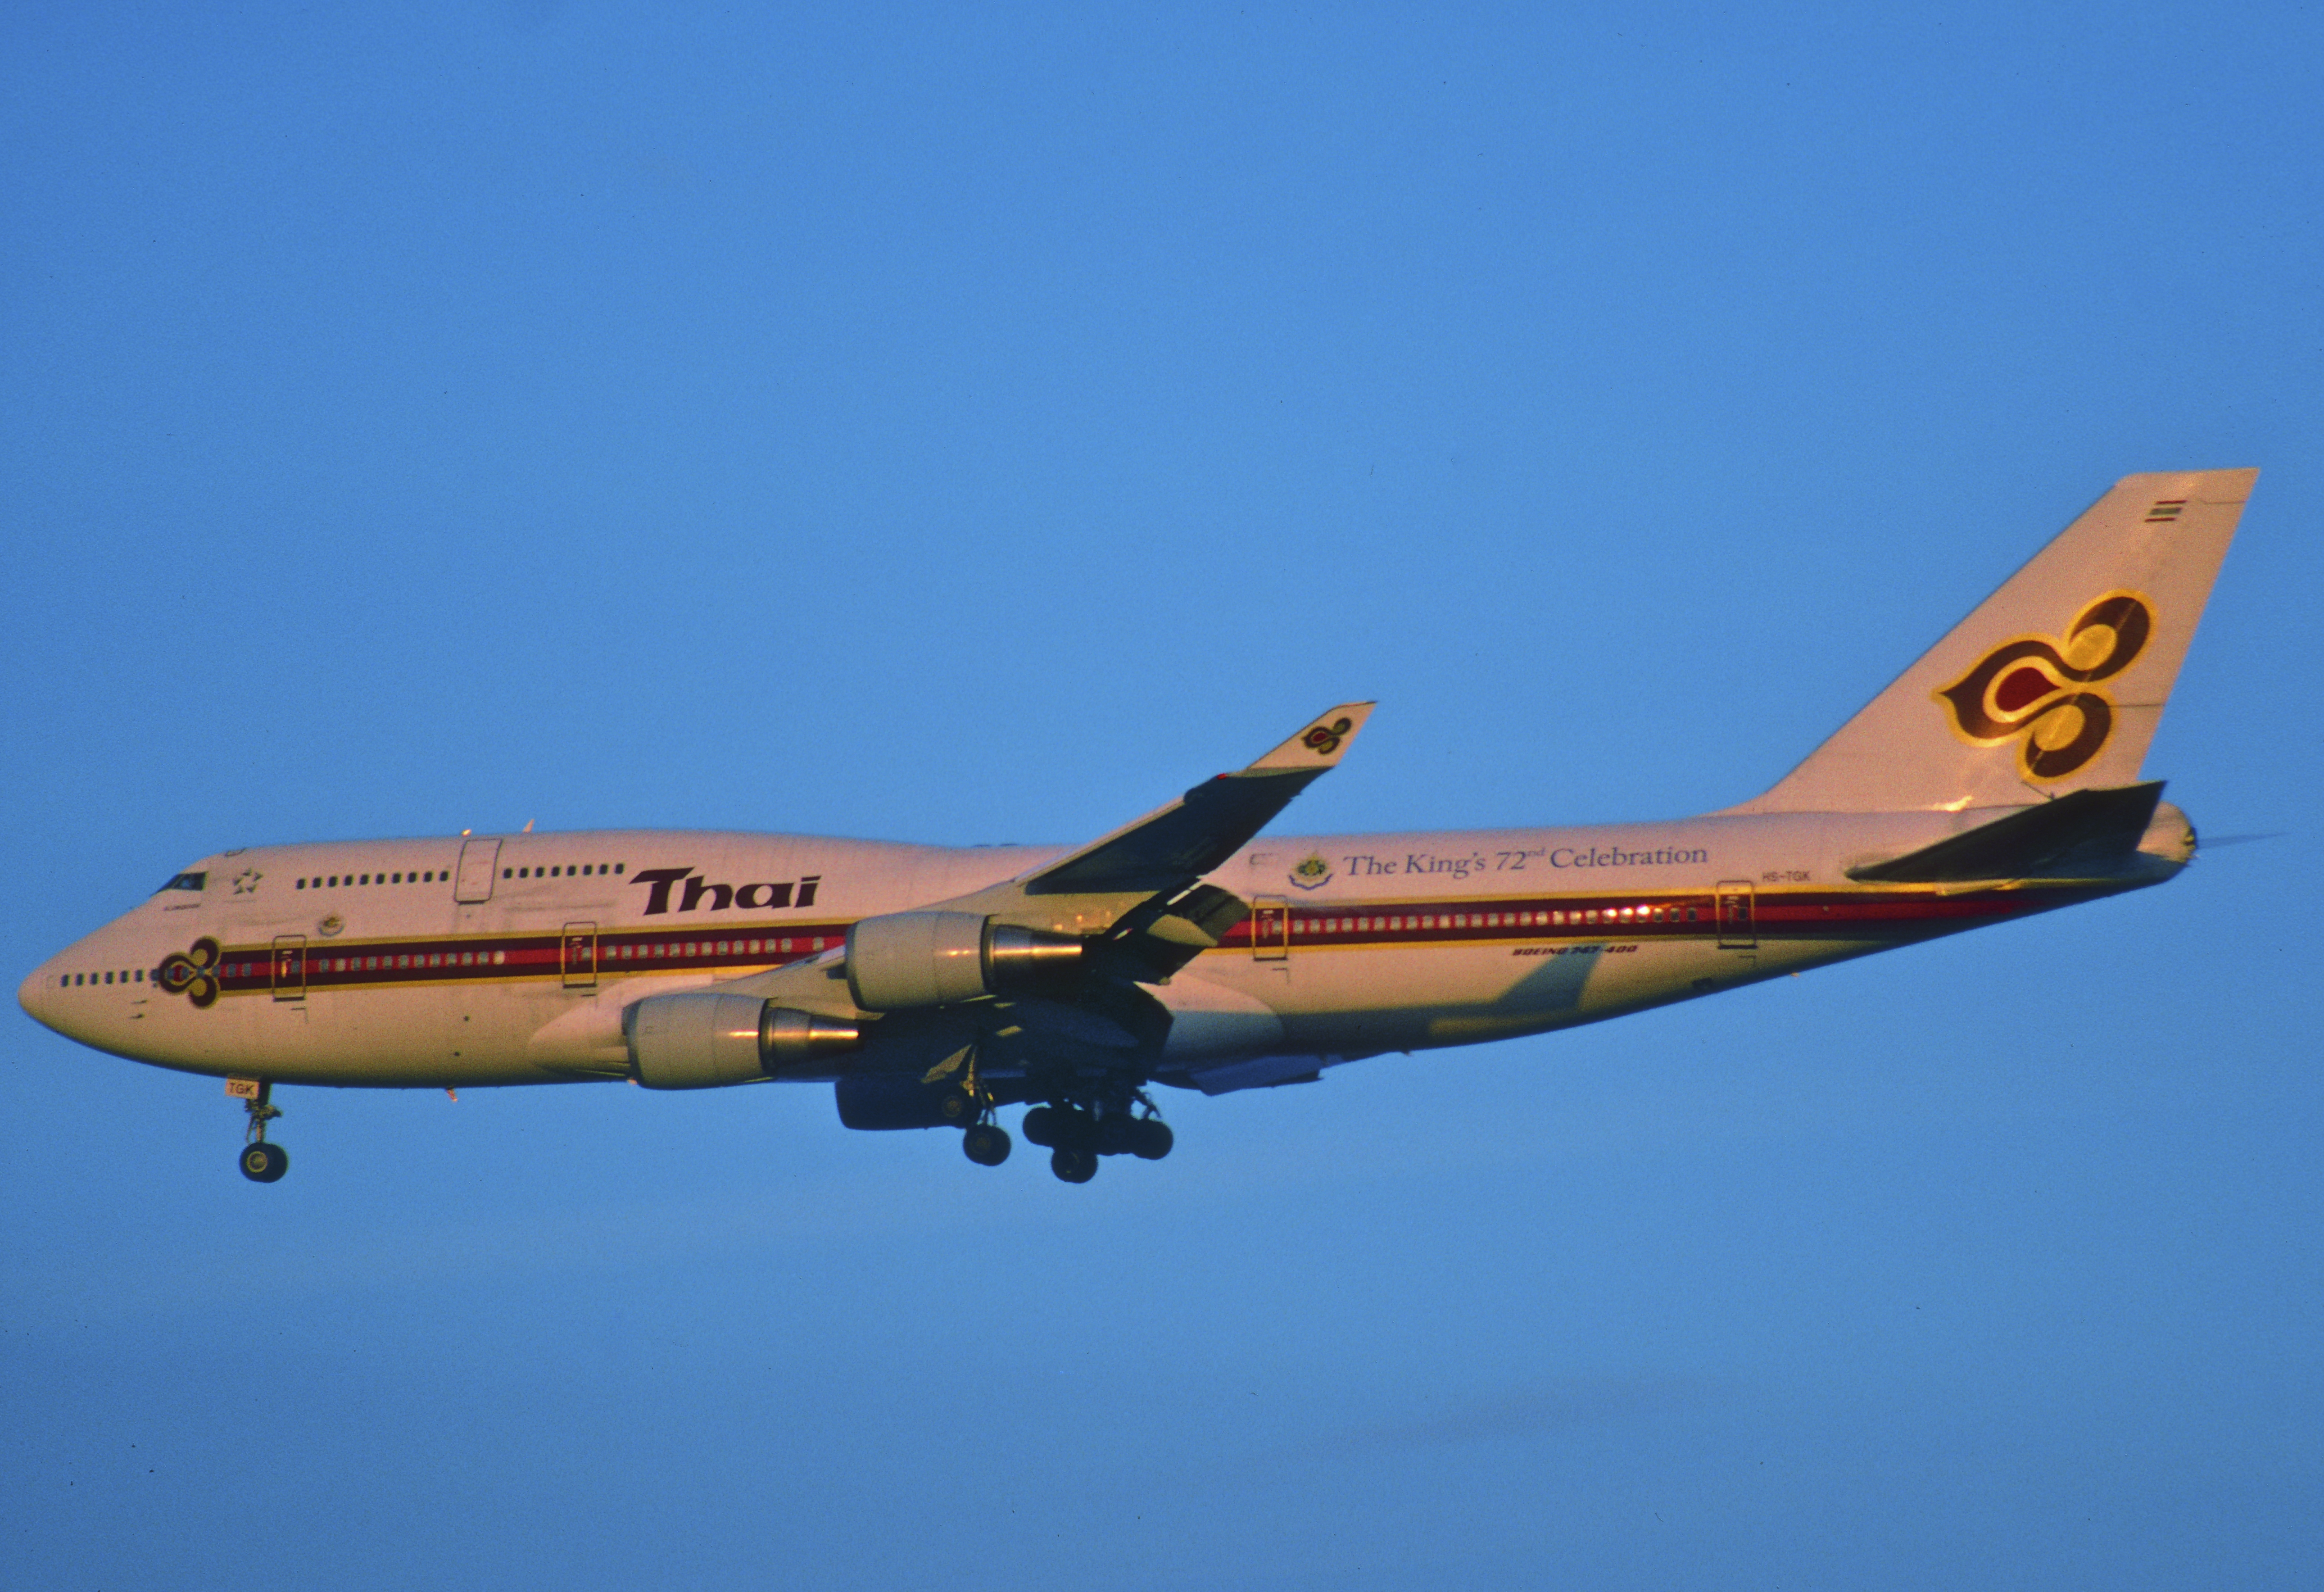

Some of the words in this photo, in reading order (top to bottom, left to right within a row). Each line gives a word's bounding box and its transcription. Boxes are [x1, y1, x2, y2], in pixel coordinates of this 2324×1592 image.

[1342, 855, 1397, 875] The
[1404, 852, 1486, 879] King's
[1550, 846, 1708, 868] Celebration
[1761, 870, 1810, 882] HS-TGK
[629, 866, 822, 916] Thai
[1512, 947, 1569, 956] BOEING
[230, 1082, 255, 1096] TGK
